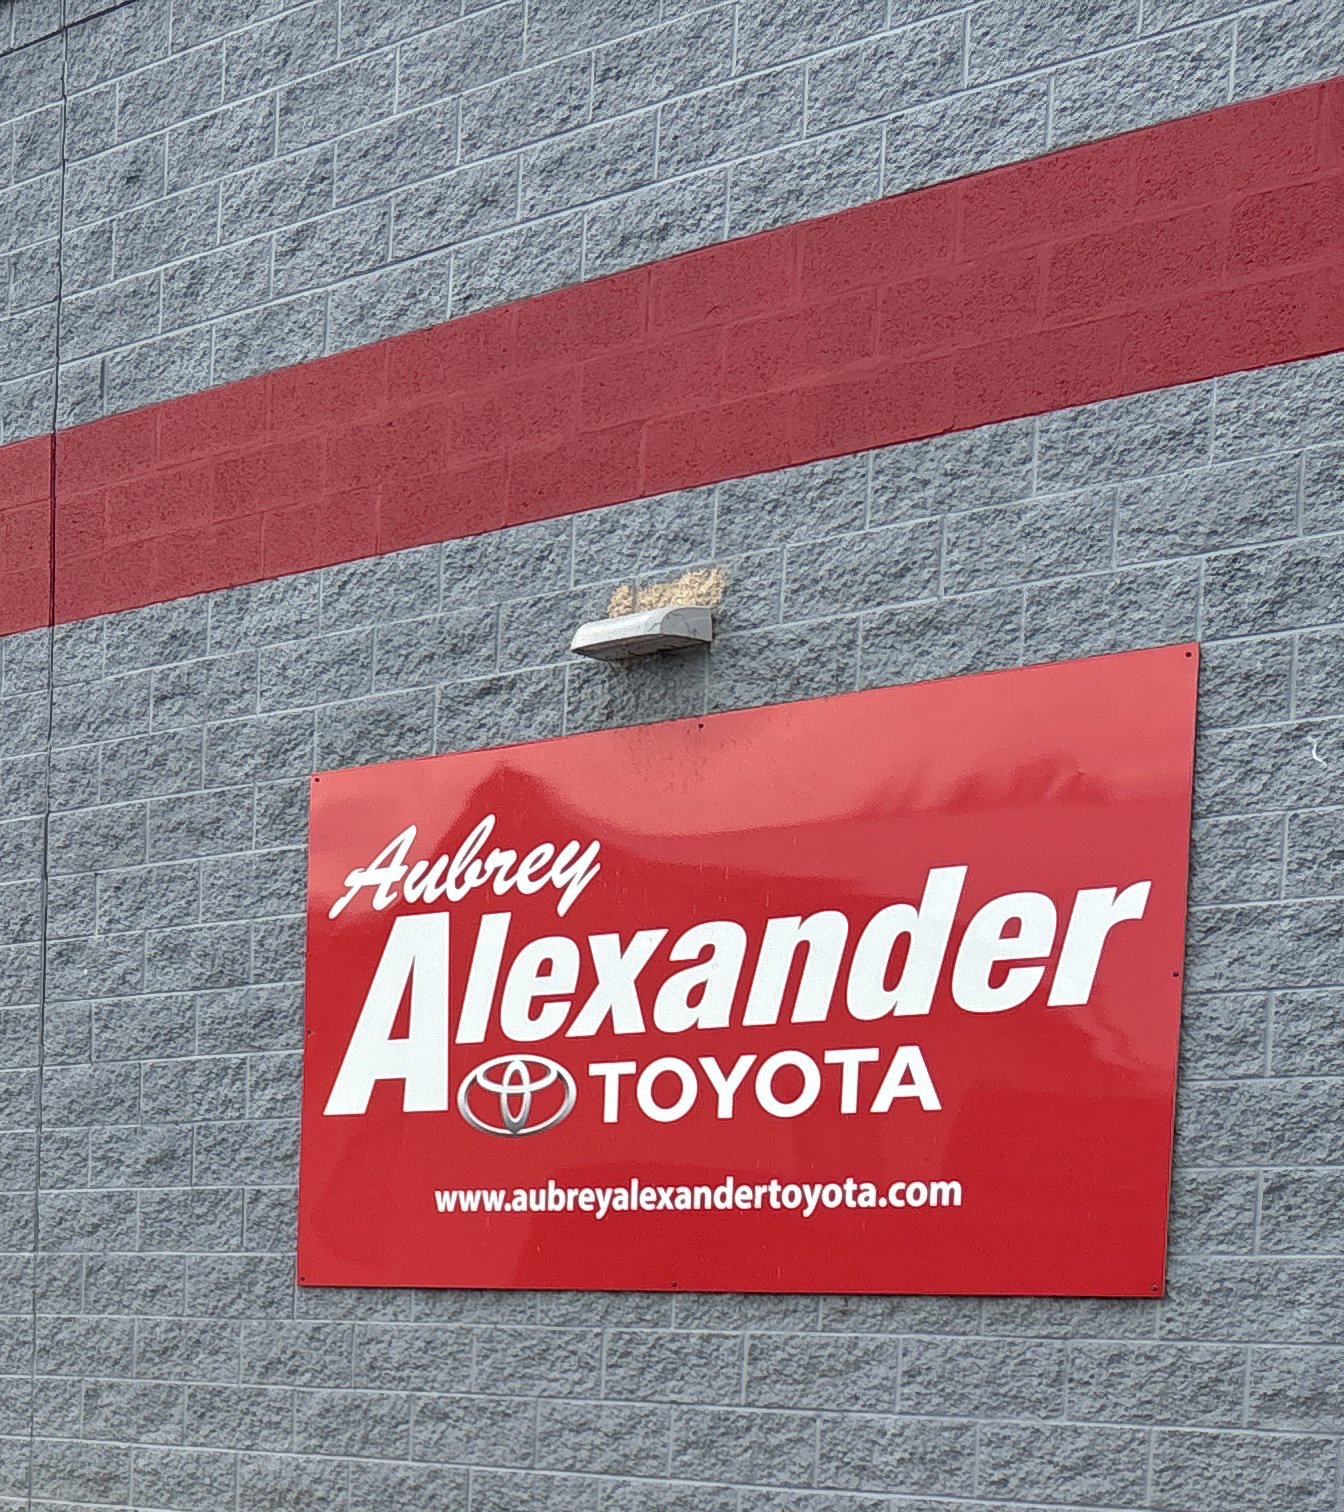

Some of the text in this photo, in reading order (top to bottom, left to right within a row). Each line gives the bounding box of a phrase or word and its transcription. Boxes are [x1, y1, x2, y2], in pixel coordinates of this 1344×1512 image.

[328, 813, 602, 921] Aubrey
[322, 865, 1153, 1117] Alexander
[588, 1044, 942, 1124] TOYOTA
[433, 1176, 962, 1220] www.aubreyalexandertoyota.com
